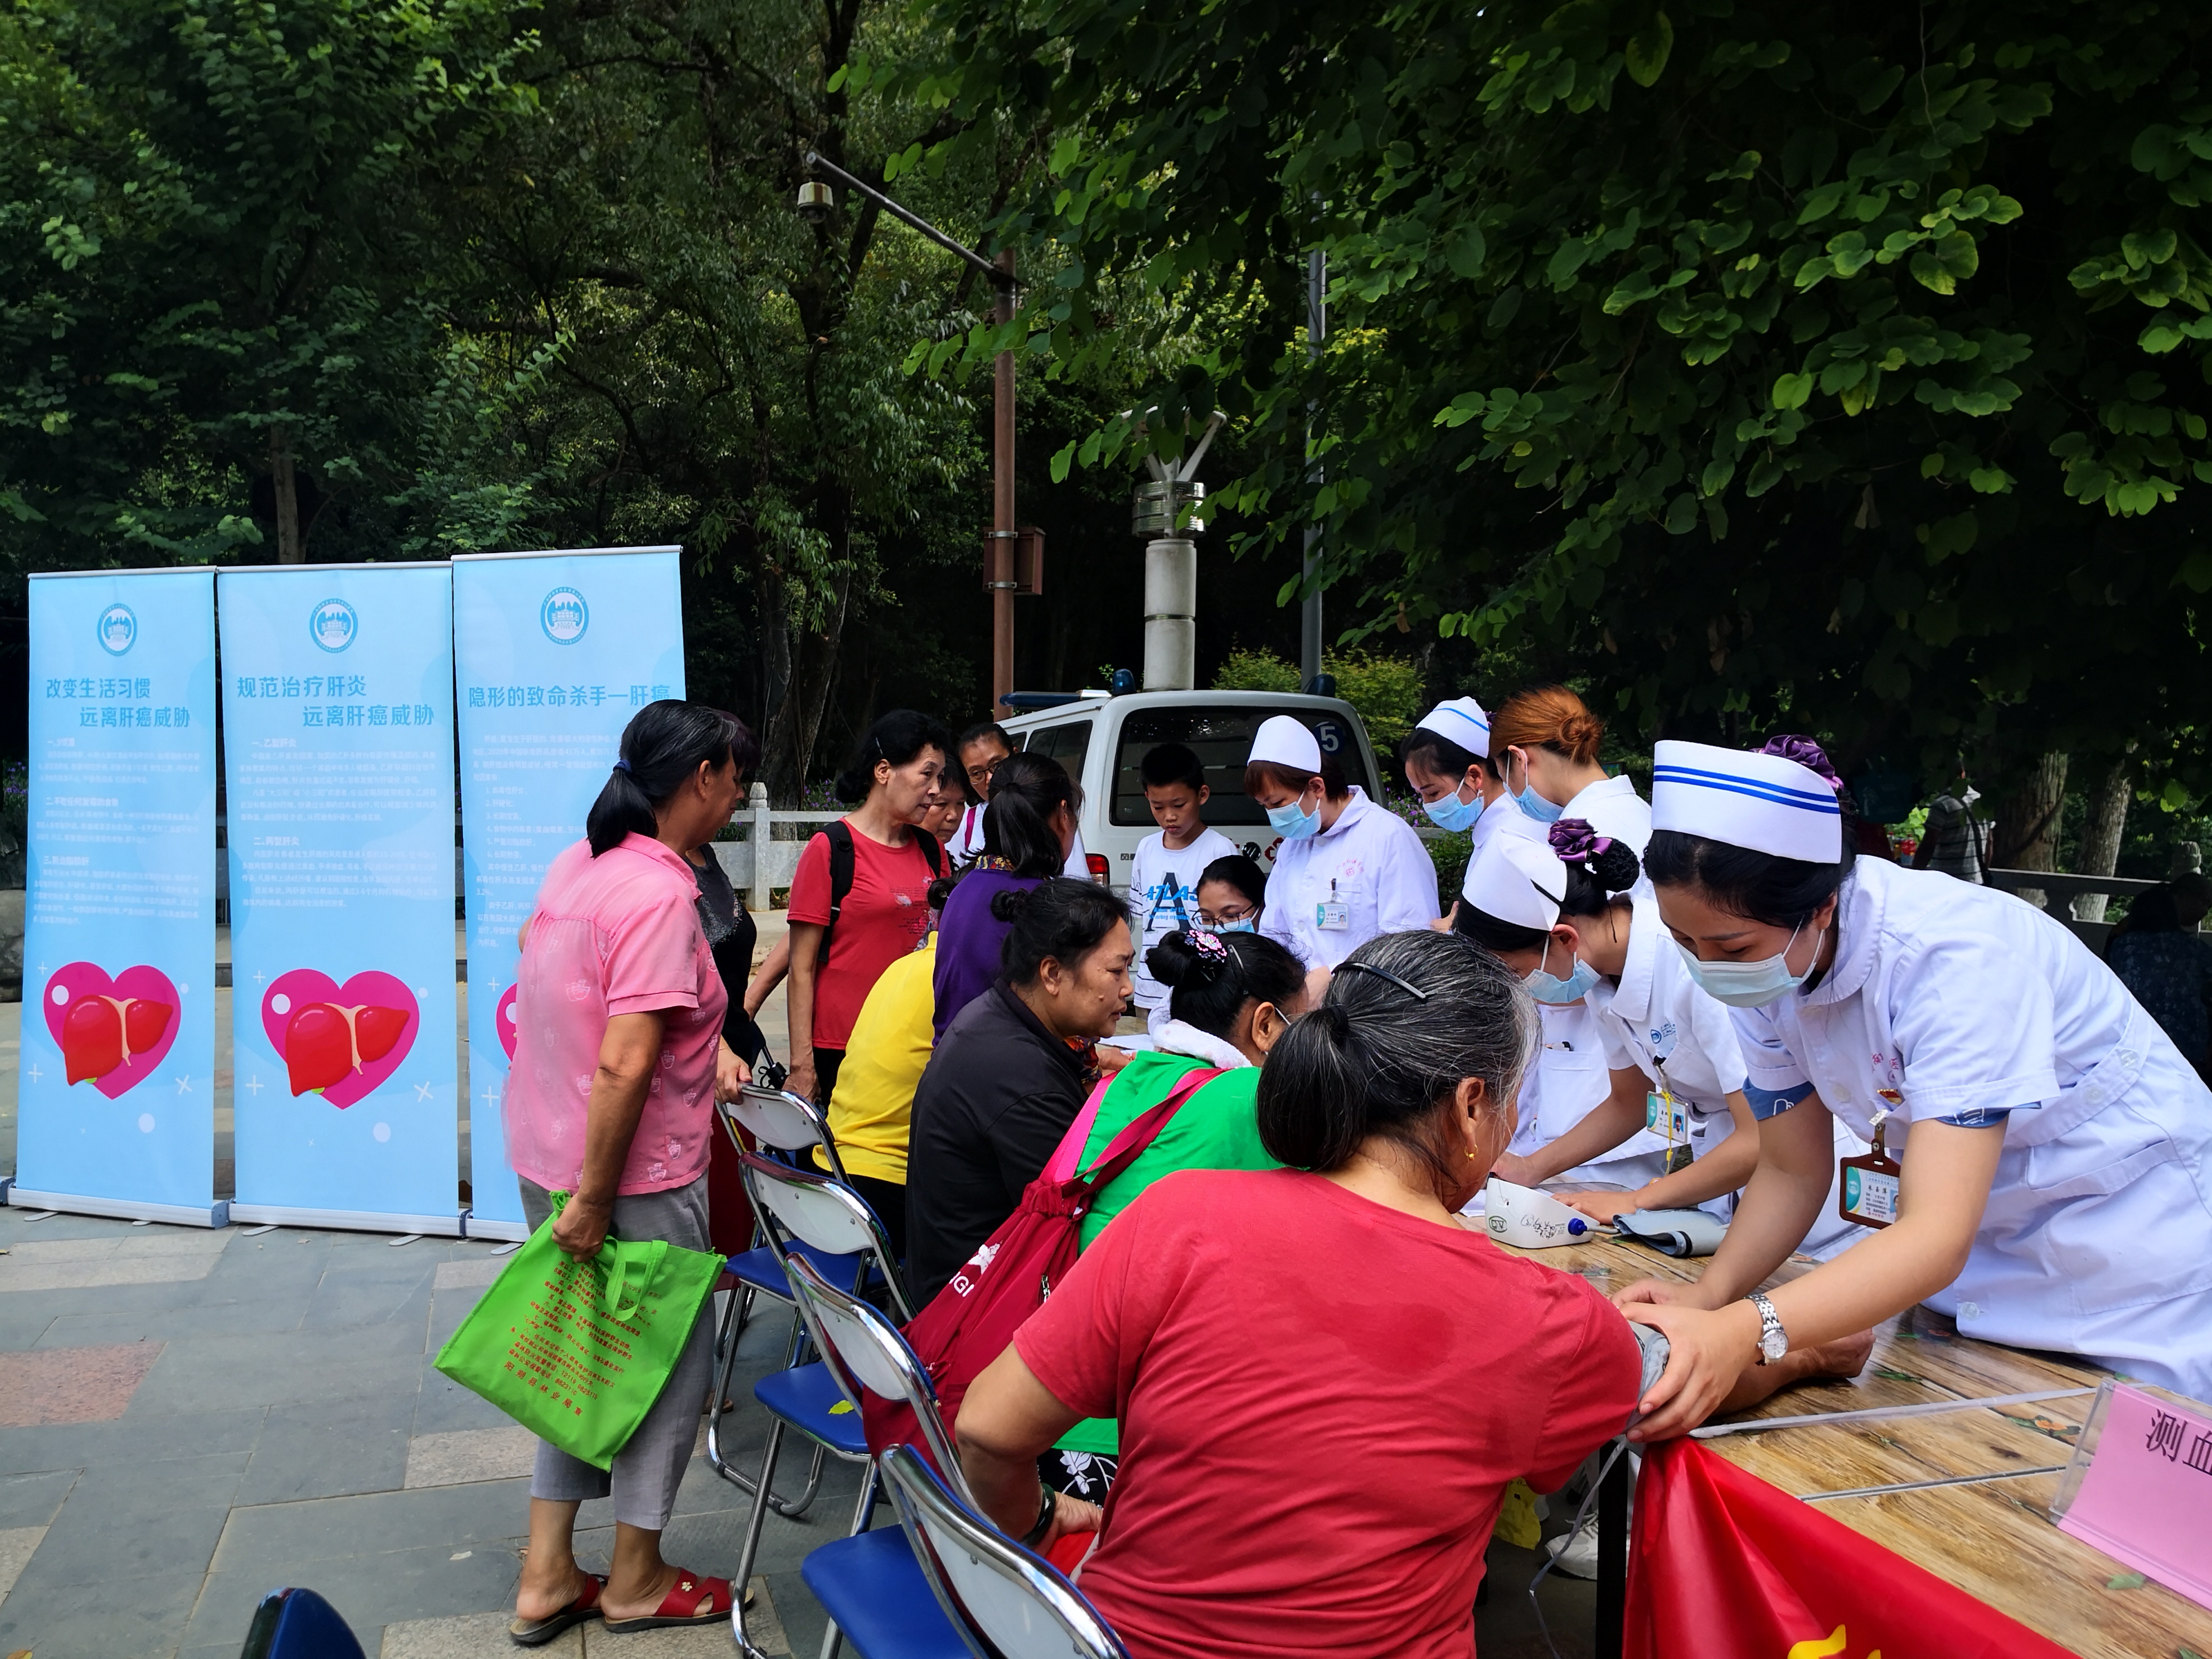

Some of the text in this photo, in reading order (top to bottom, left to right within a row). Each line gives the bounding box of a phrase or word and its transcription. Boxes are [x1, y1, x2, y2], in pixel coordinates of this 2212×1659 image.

[46, 678, 151, 699] 改变生活习惯
[237, 675, 367, 698] 规范治疗肝炎
[79, 706, 191, 728] 远离肝癌威胁
[303, 704, 434, 727] 远离肝癌威胁
[1320, 725, 1340, 752] 5
